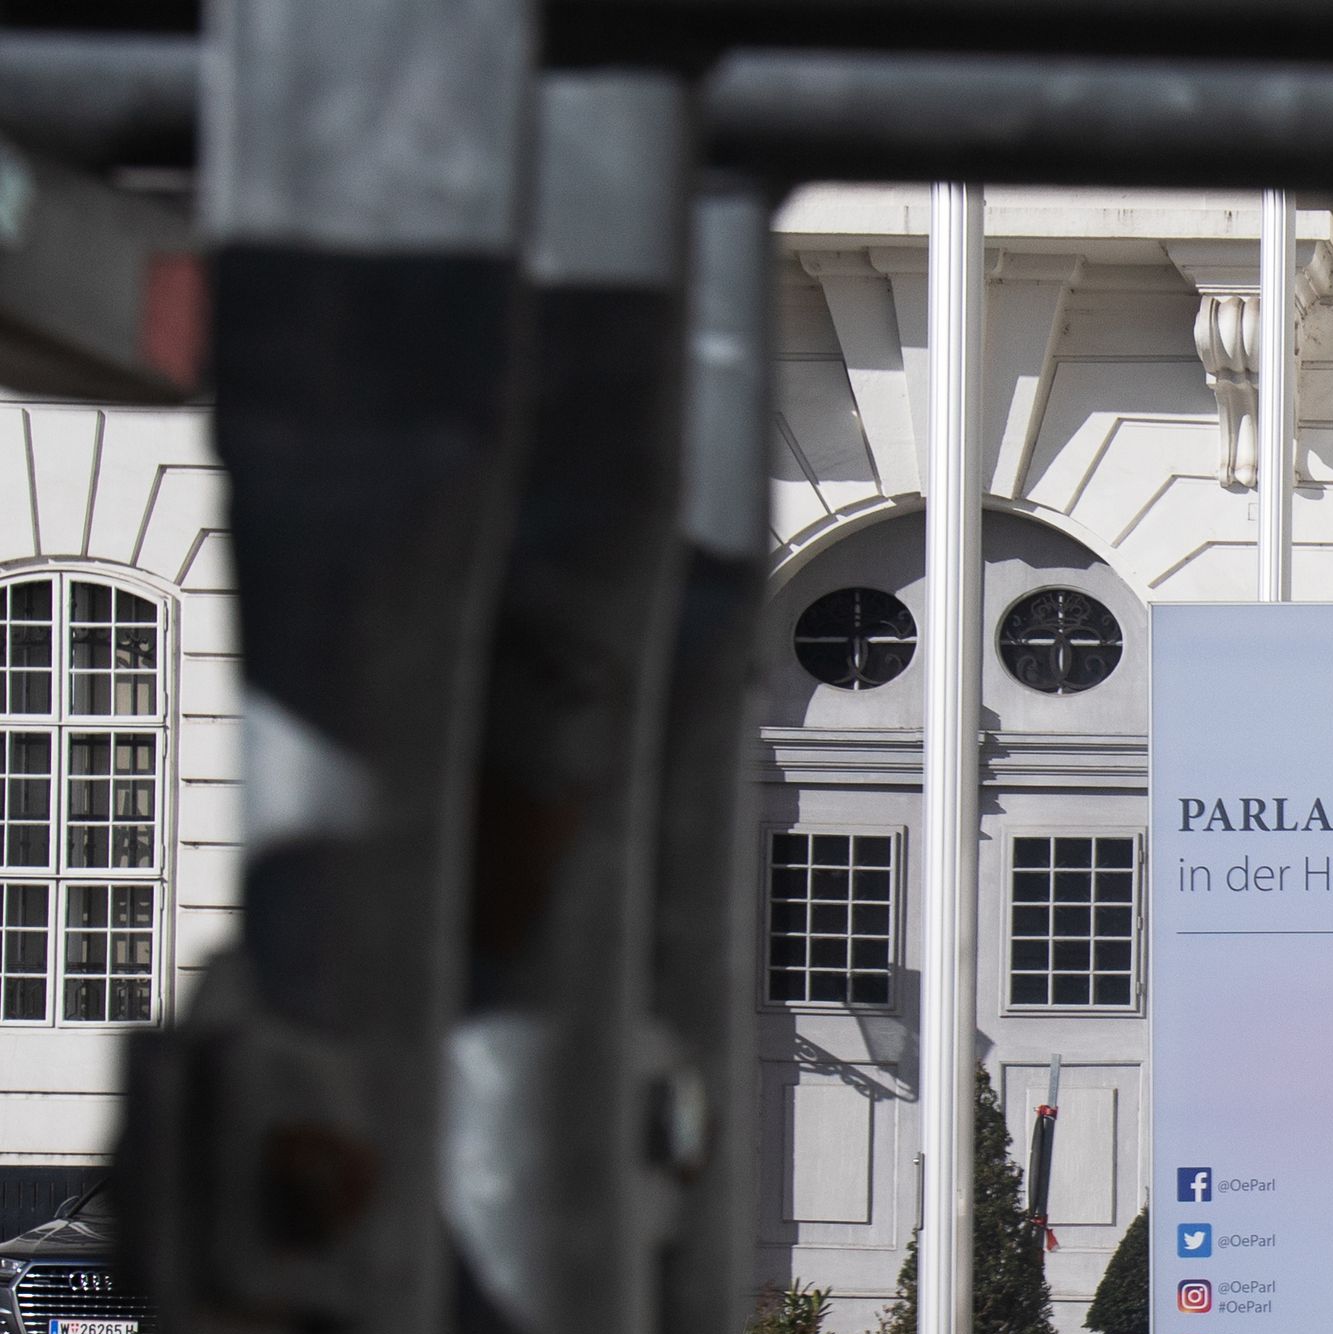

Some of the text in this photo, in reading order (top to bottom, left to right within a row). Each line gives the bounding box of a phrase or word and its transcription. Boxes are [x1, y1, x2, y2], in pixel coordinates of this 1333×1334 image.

[1179, 857, 1211, 892] in
[1226, 854, 1290, 892] der
[1217, 1177, 1276, 1194] @OeParl
[1217, 1233, 1276, 1250] @OeParl
[1217, 1279, 1276, 1296] @OeParl
[1218, 1300, 1272, 1314] #OeParl
